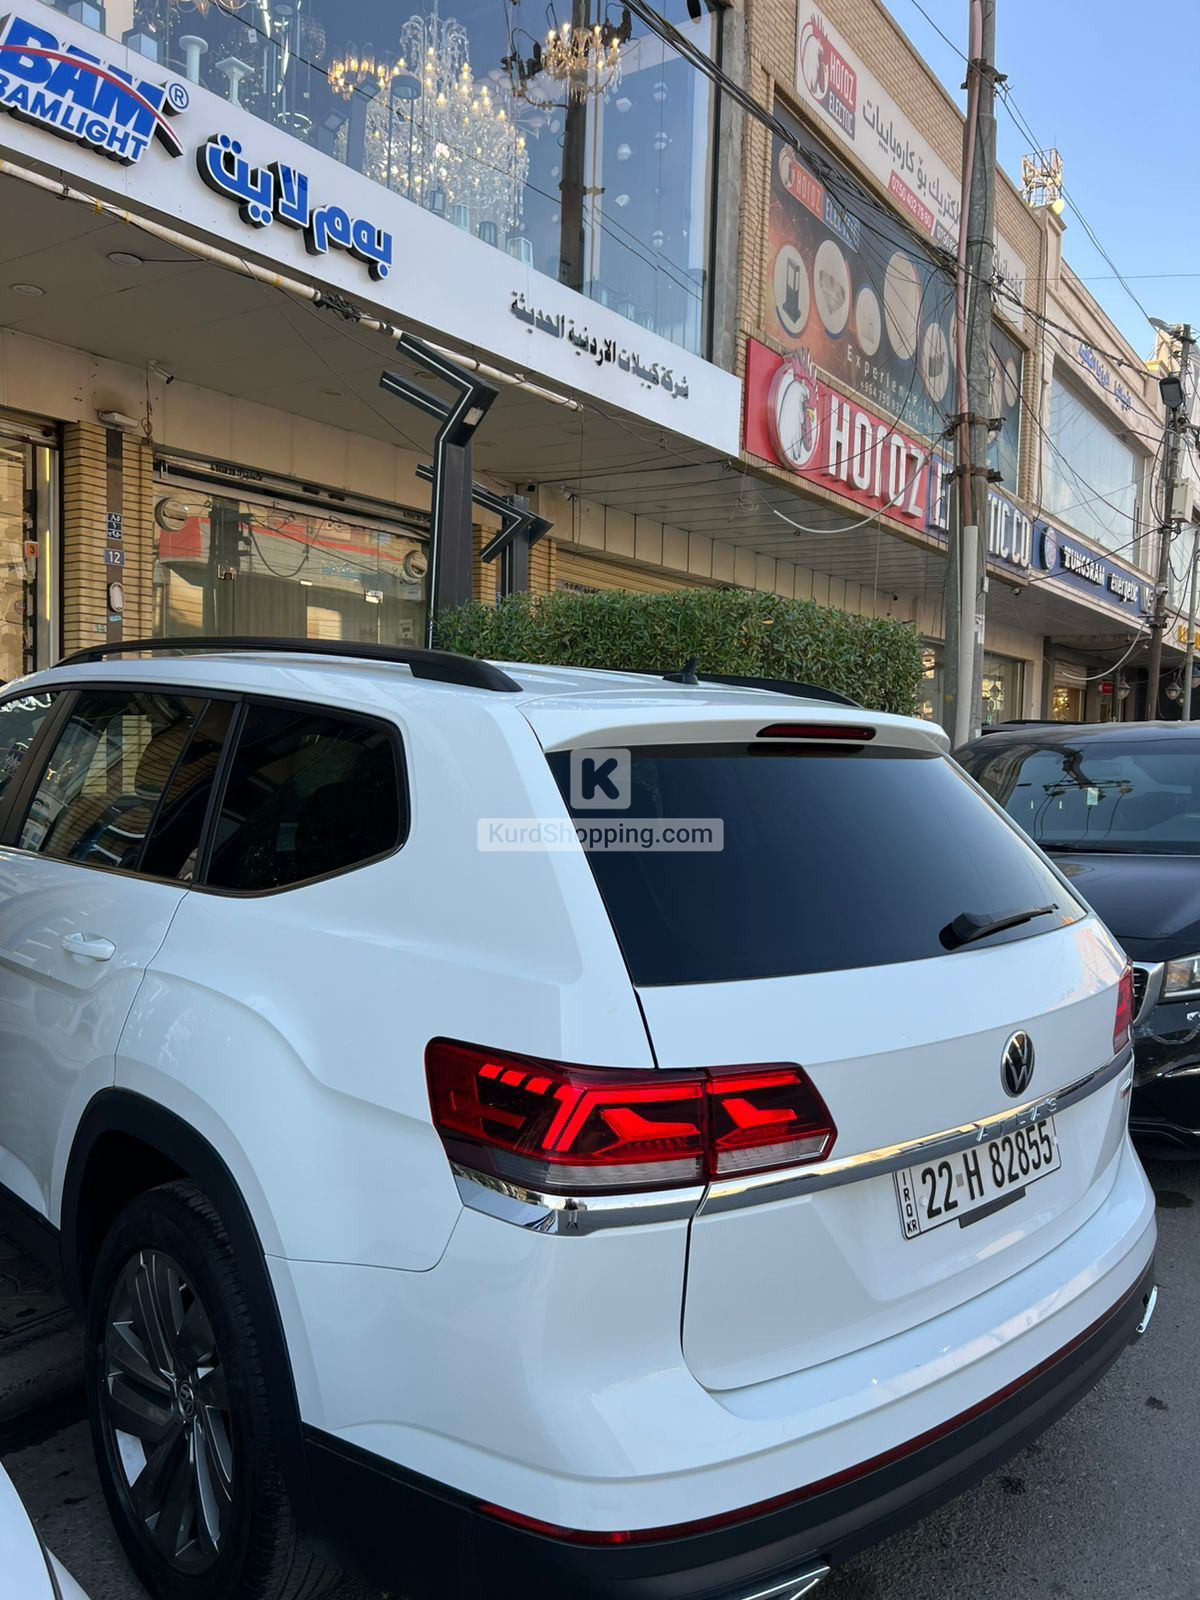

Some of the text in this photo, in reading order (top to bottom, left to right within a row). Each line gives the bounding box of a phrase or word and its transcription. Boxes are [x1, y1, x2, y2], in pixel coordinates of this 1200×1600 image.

[0, 16, 164, 138] BAM
[0, 74, 148, 160] BAMLIGHT
[510, 290, 565, 338] الحديثة
[568, 318, 617, 366] الاردنية
[660, 366, 689, 400] شركة
[109, 551, 120, 564] 12
[921, 1120, 1054, 1219] 22 H 82855
[906, 1219, 918, 1234] KR
